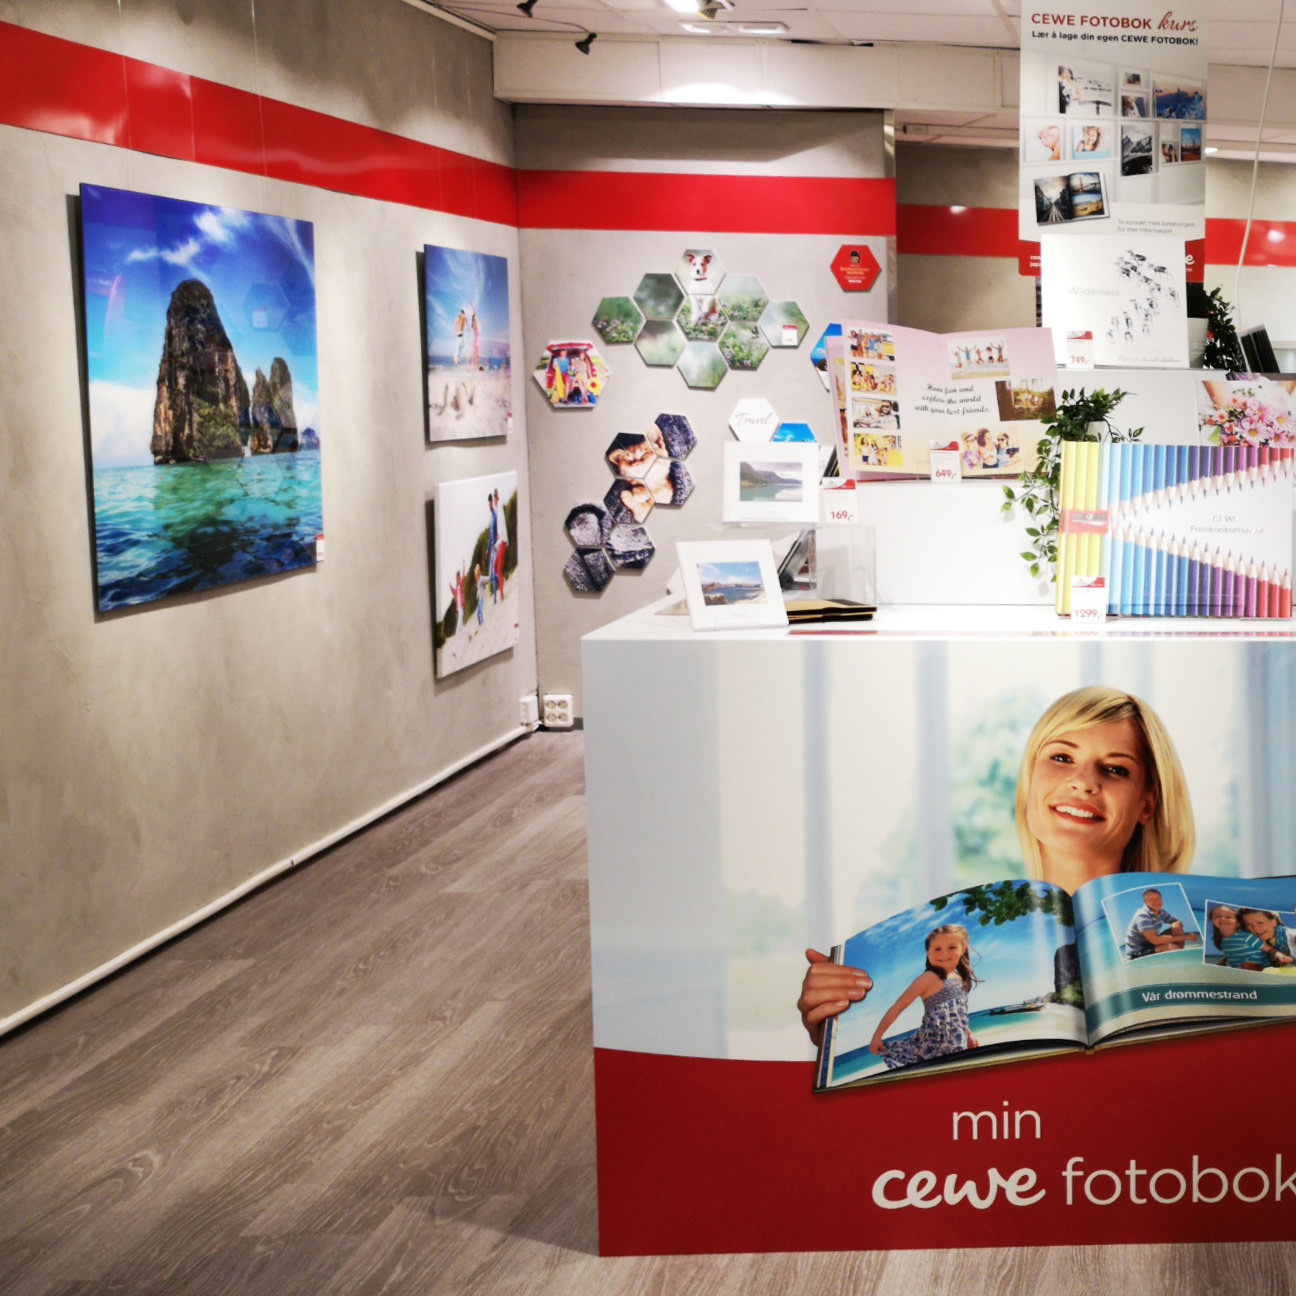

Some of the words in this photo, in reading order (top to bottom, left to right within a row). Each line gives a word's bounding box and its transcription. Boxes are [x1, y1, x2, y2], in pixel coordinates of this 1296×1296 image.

[1031, 13, 1075, 26] CEWE
[1080, 15, 1152, 30] FOTOBOK
[1157, 11, 1198, 32] kurs
[1032, 30, 1049, 39] Lær
[1051, 31, 1057, 39] å
[1059, 31, 1078, 42] lage
[1081, 32, 1095, 41] din
[1097, 34, 1119, 43] egen
[1121, 34, 1148, 43] CEWE
[1151, 36, 1198, 46] FOTOBOK!
[1141, 989, 1162, 1002] Vår
[1164, 988, 1258, 1002] drømmestrand
[952, 1100, 1041, 1140] min
[871, 1166, 1046, 1210] cewe
